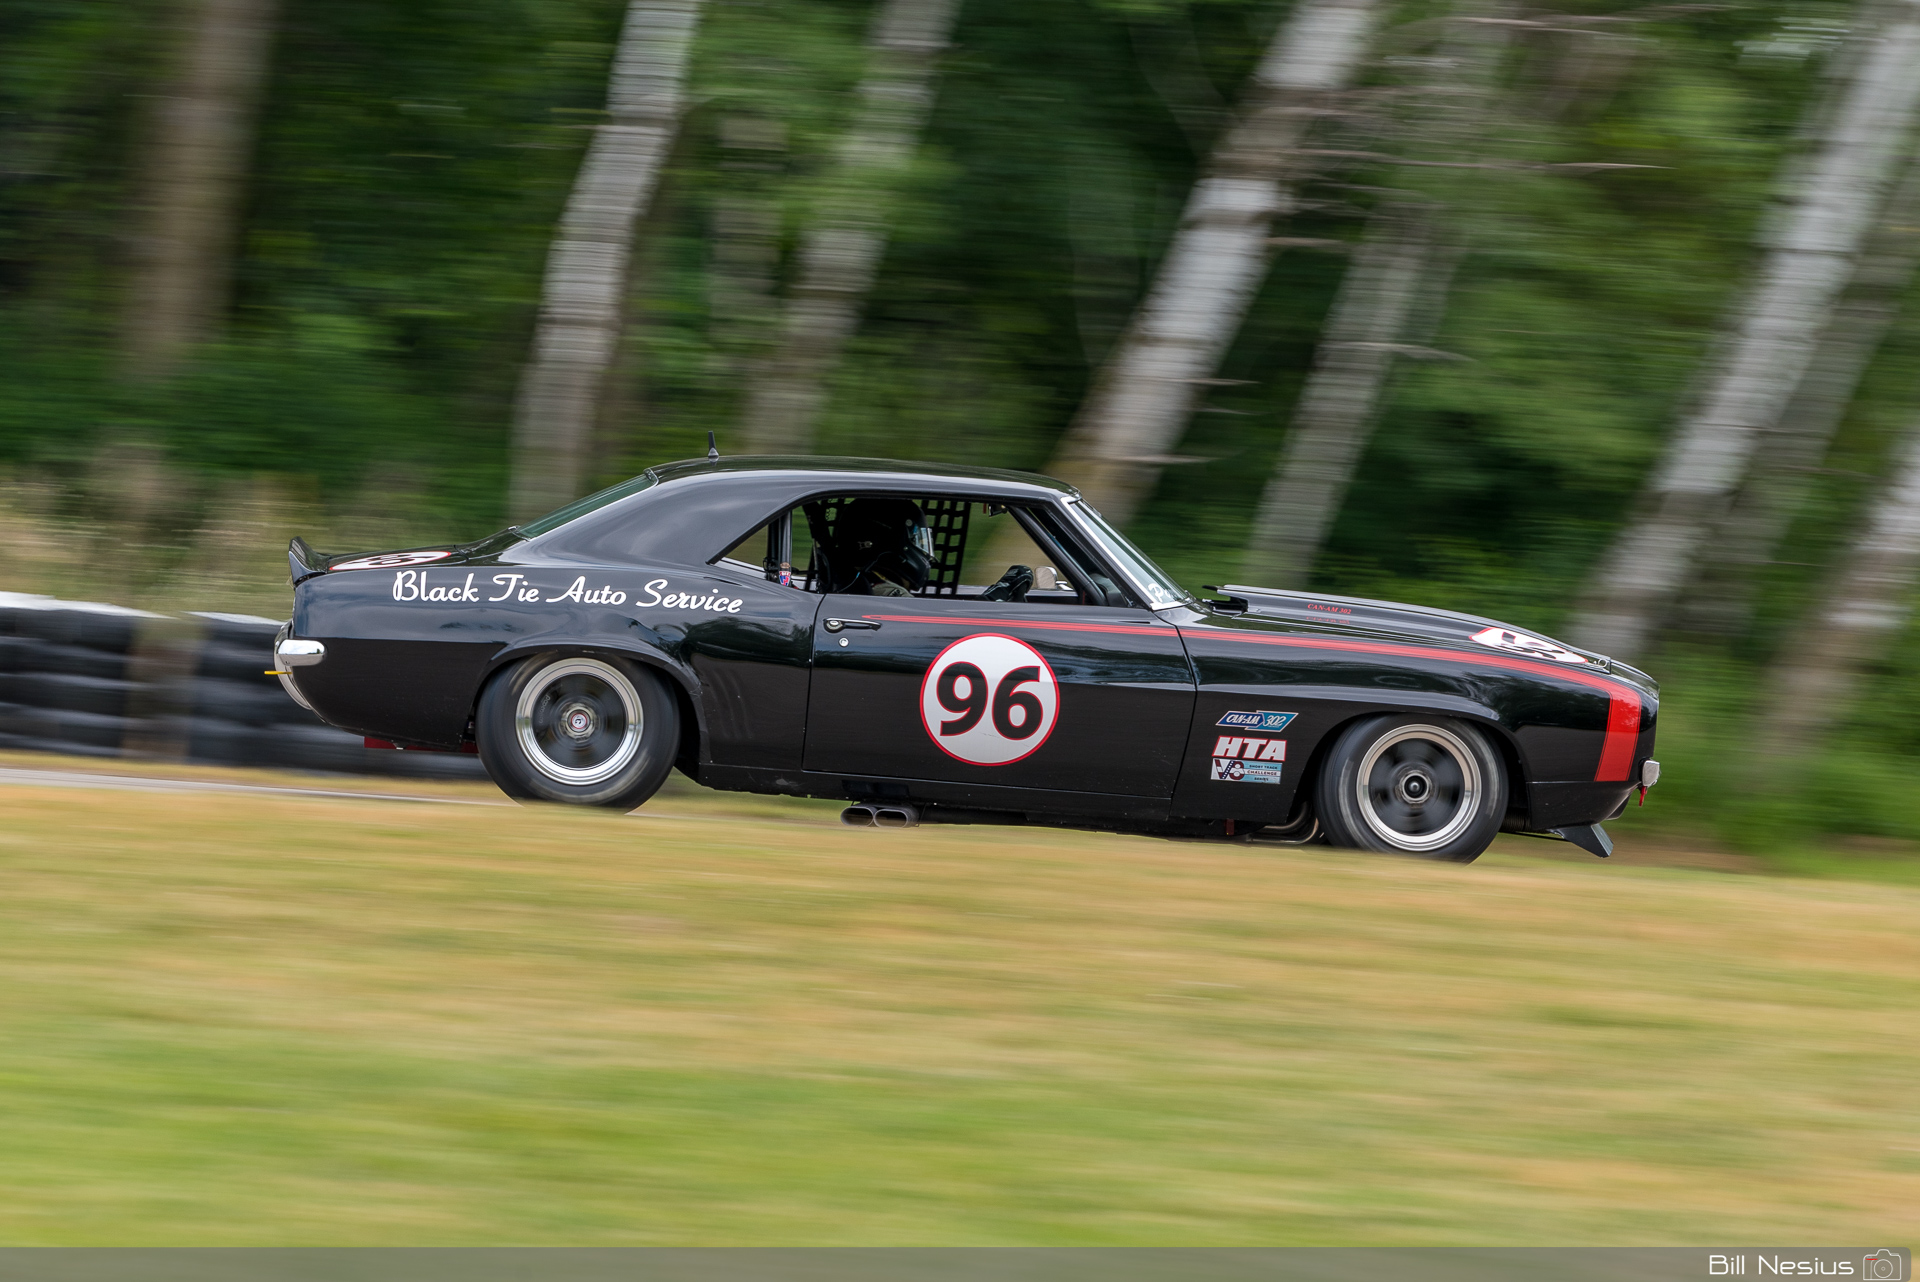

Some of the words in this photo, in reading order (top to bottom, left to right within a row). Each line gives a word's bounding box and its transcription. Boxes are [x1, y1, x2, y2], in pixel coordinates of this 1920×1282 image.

[392, 569, 480, 602] Black
[488, 573, 540, 602] Tie
[546, 575, 628, 605] Auto
[635, 578, 744, 614] Service
[1307, 603, 1338, 612] CAN-AM
[936, 660, 1044, 741] 96
[1226, 714, 1261, 725] CAN-AM
[1263, 715, 1287, 727] 302
[1212, 736, 1287, 761] HTA
[1214, 759, 1245, 780] V8
